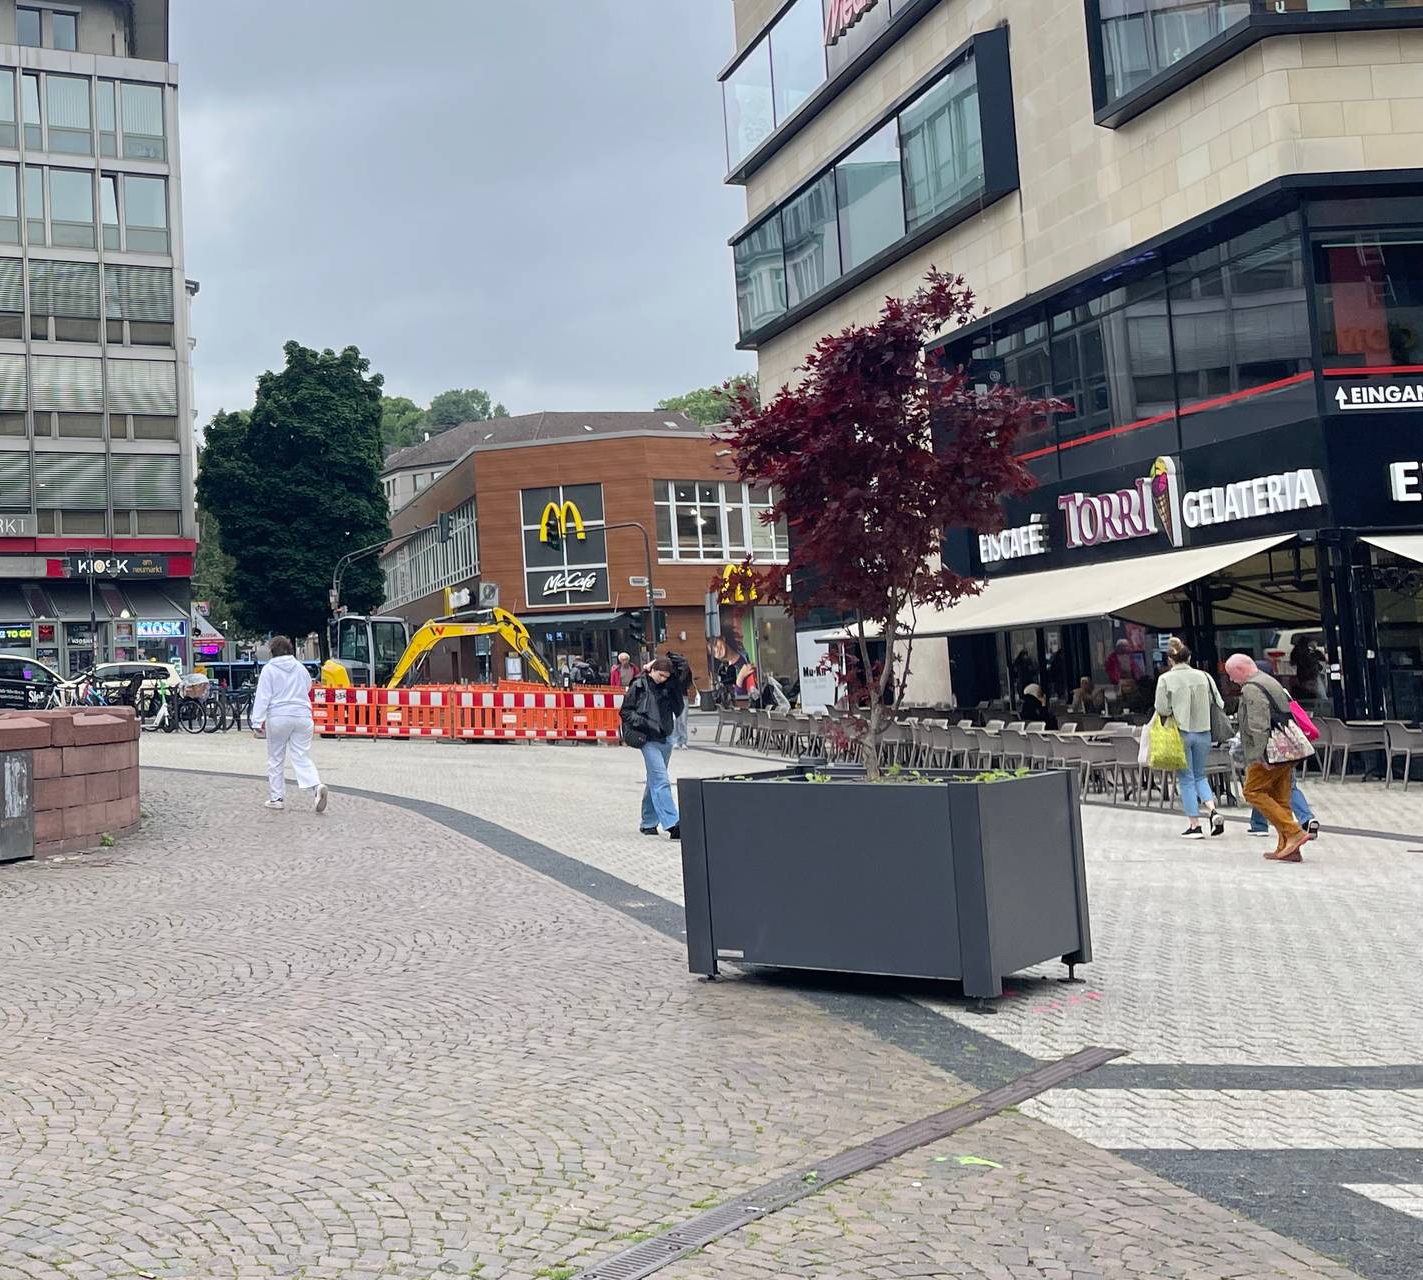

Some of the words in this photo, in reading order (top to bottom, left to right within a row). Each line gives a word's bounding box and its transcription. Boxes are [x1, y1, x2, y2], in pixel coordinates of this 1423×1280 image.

[979, 513, 1045, 563] EISCAFÉ
[1058, 477, 1158, 549] TORRI
[1182, 469, 1322, 528] GELATERIA
[78, 559, 129, 574] KIOSK
[6, 630, 18, 638] TO
[19, 629, 33, 637] GO
[137, 621, 182, 636] KIOSK
